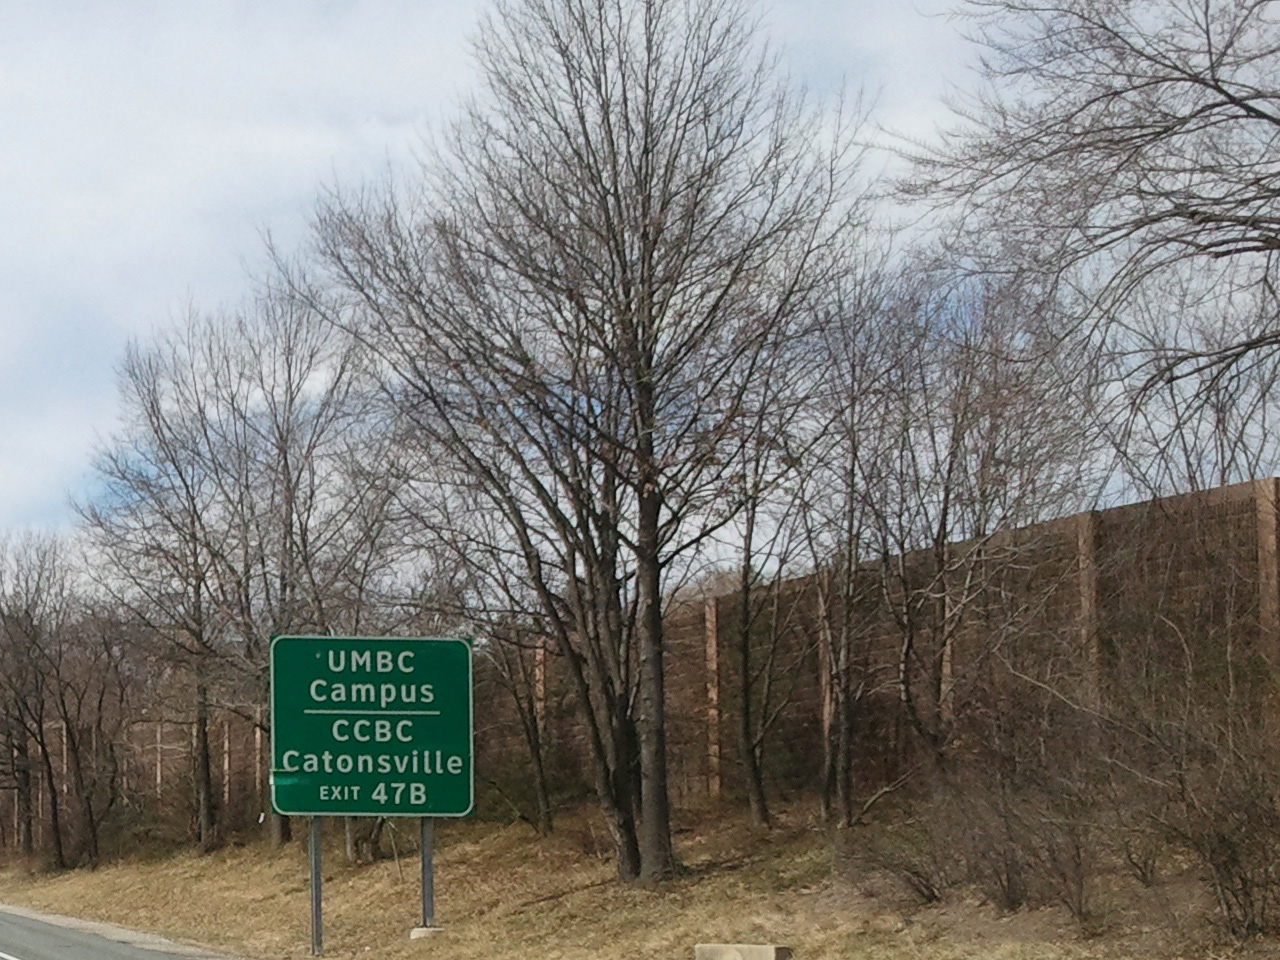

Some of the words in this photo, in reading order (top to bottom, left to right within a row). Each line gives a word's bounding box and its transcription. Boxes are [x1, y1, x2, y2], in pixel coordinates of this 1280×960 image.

[328, 650, 415, 673] UMBC
[310, 679, 434, 708] Campus
[332, 719, 413, 742] CCBC
[282, 750, 463, 774] Catonsville
[319, 786, 361, 800] EXIT
[371, 783, 427, 805] 47B
